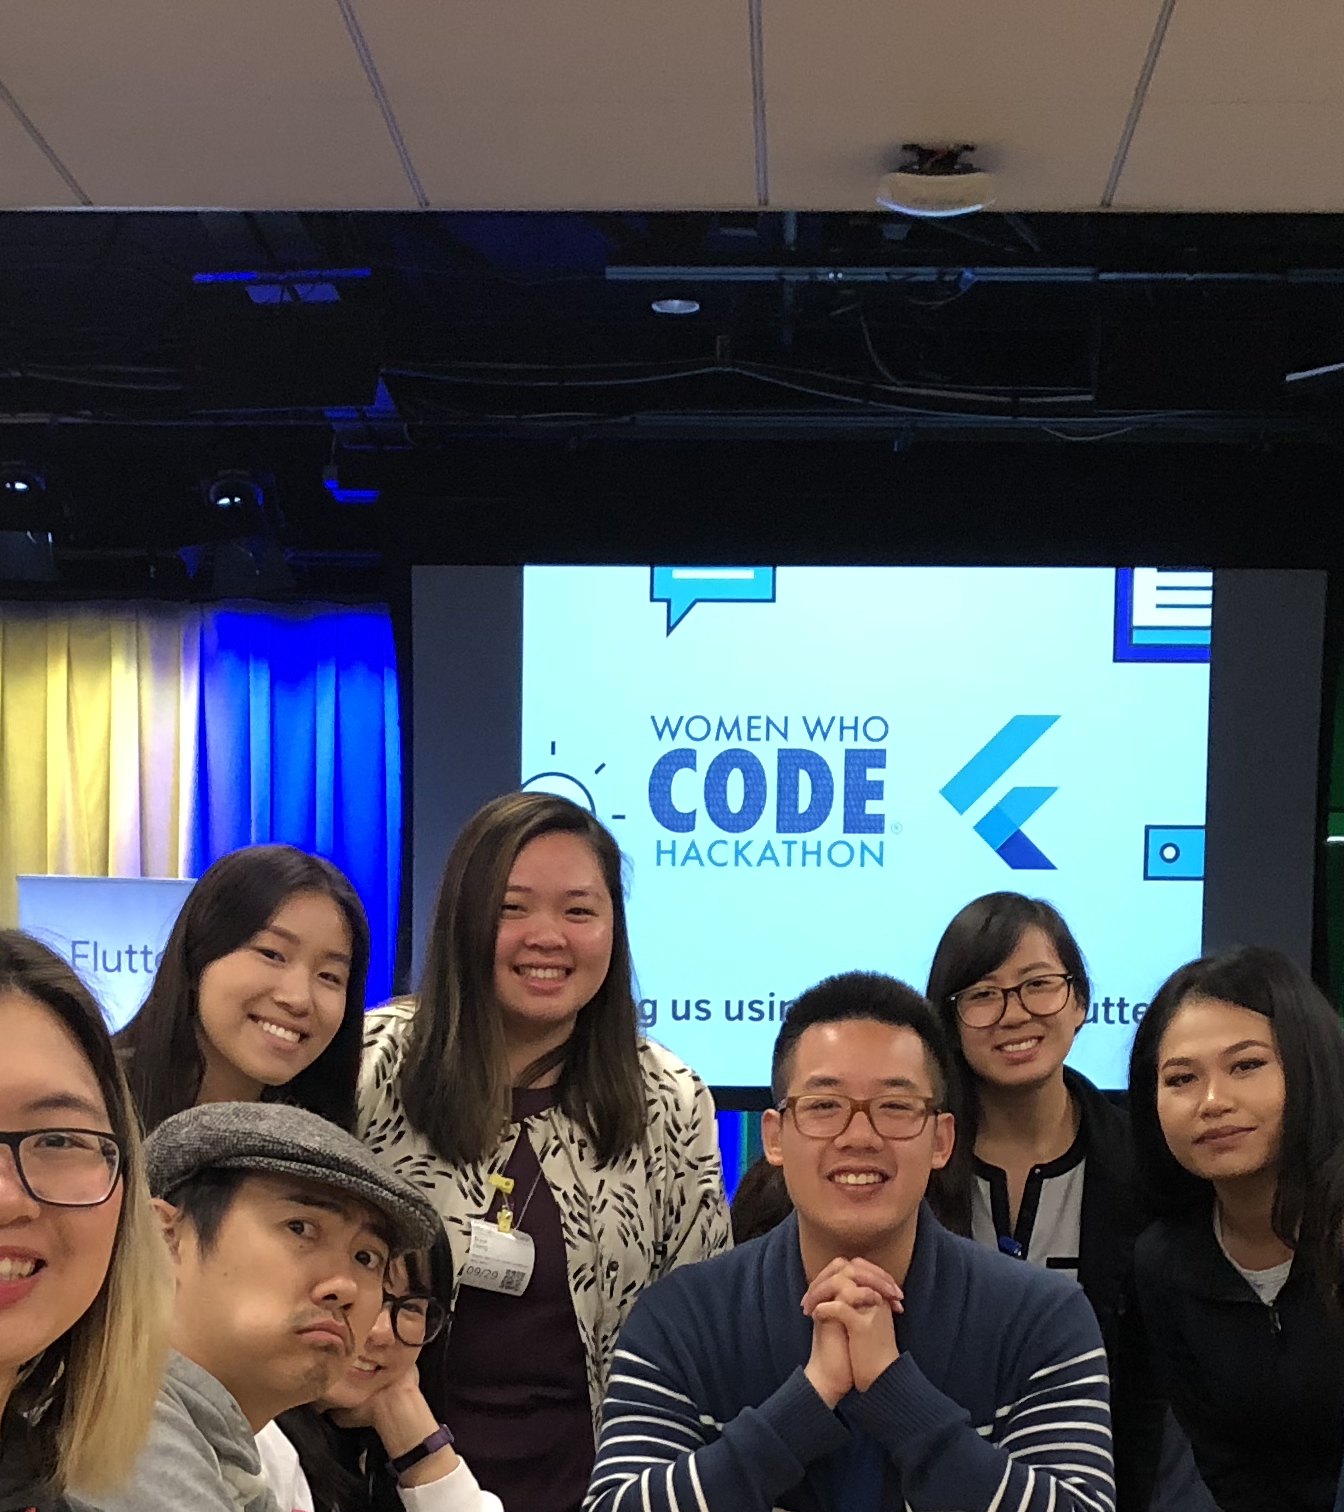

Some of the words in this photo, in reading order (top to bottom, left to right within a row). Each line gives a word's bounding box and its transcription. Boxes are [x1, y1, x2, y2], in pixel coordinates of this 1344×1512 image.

[650, 714, 789, 742] WOMEN
[802, 715, 889, 742] WHO
[648, 747, 887, 834] CODE
[656, 839, 885, 867] HACKATHON
[671, 998, 712, 1022] us
[466, 1265, 499, 1279] 09/29
